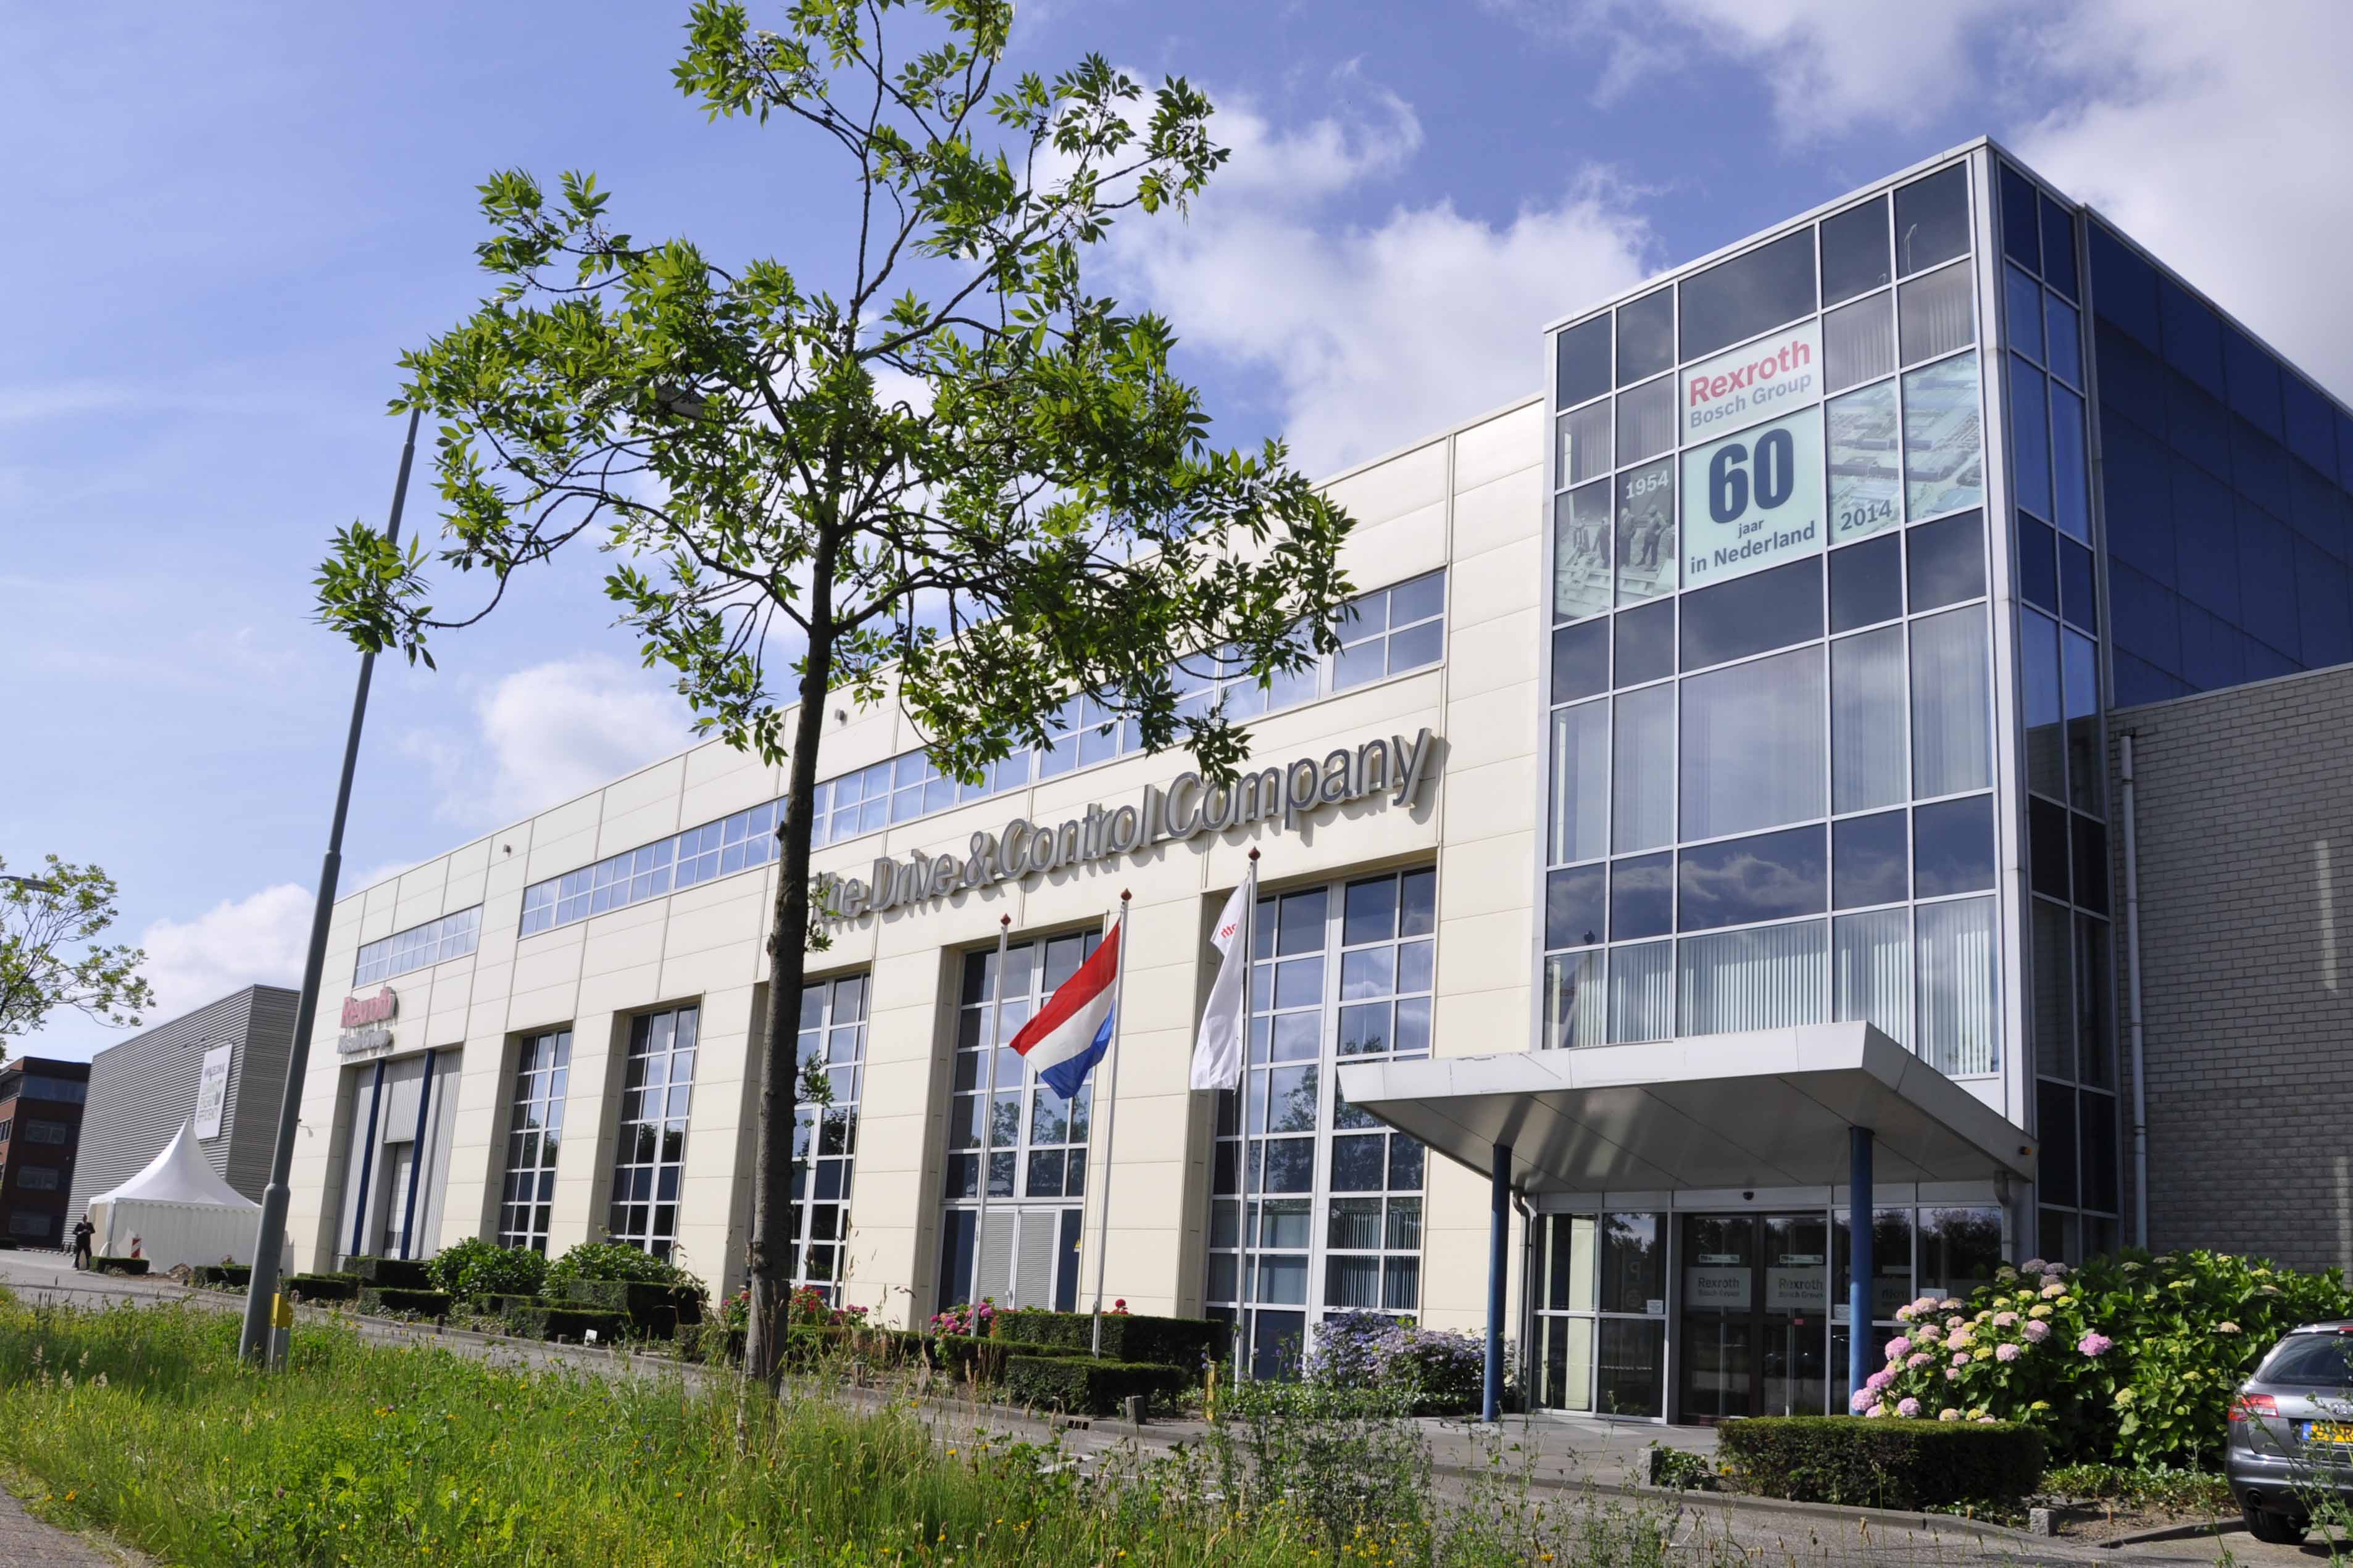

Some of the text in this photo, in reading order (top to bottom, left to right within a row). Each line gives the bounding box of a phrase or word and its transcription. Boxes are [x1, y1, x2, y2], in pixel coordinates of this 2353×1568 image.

[1690, 341, 1810, 407] Rexroth
[1691, 374, 1811, 428] Bosch Group
[1626, 470, 1668, 499] 1954
[1709, 428, 1794, 524] 60
[1738, 520, 1764, 539] jaar
[1841, 499, 1892, 531] 2014
[1691, 520, 1815, 574] in Nederland
[870, 849, 960, 910] Drive
[963, 831, 993, 889] &
[999, 784, 1154, 879] Control
[1165, 728, 1431, 839] Company
[1698, 1277, 1739, 1288] Rexroth
[1778, 1278, 1823, 1290] Rexroth
